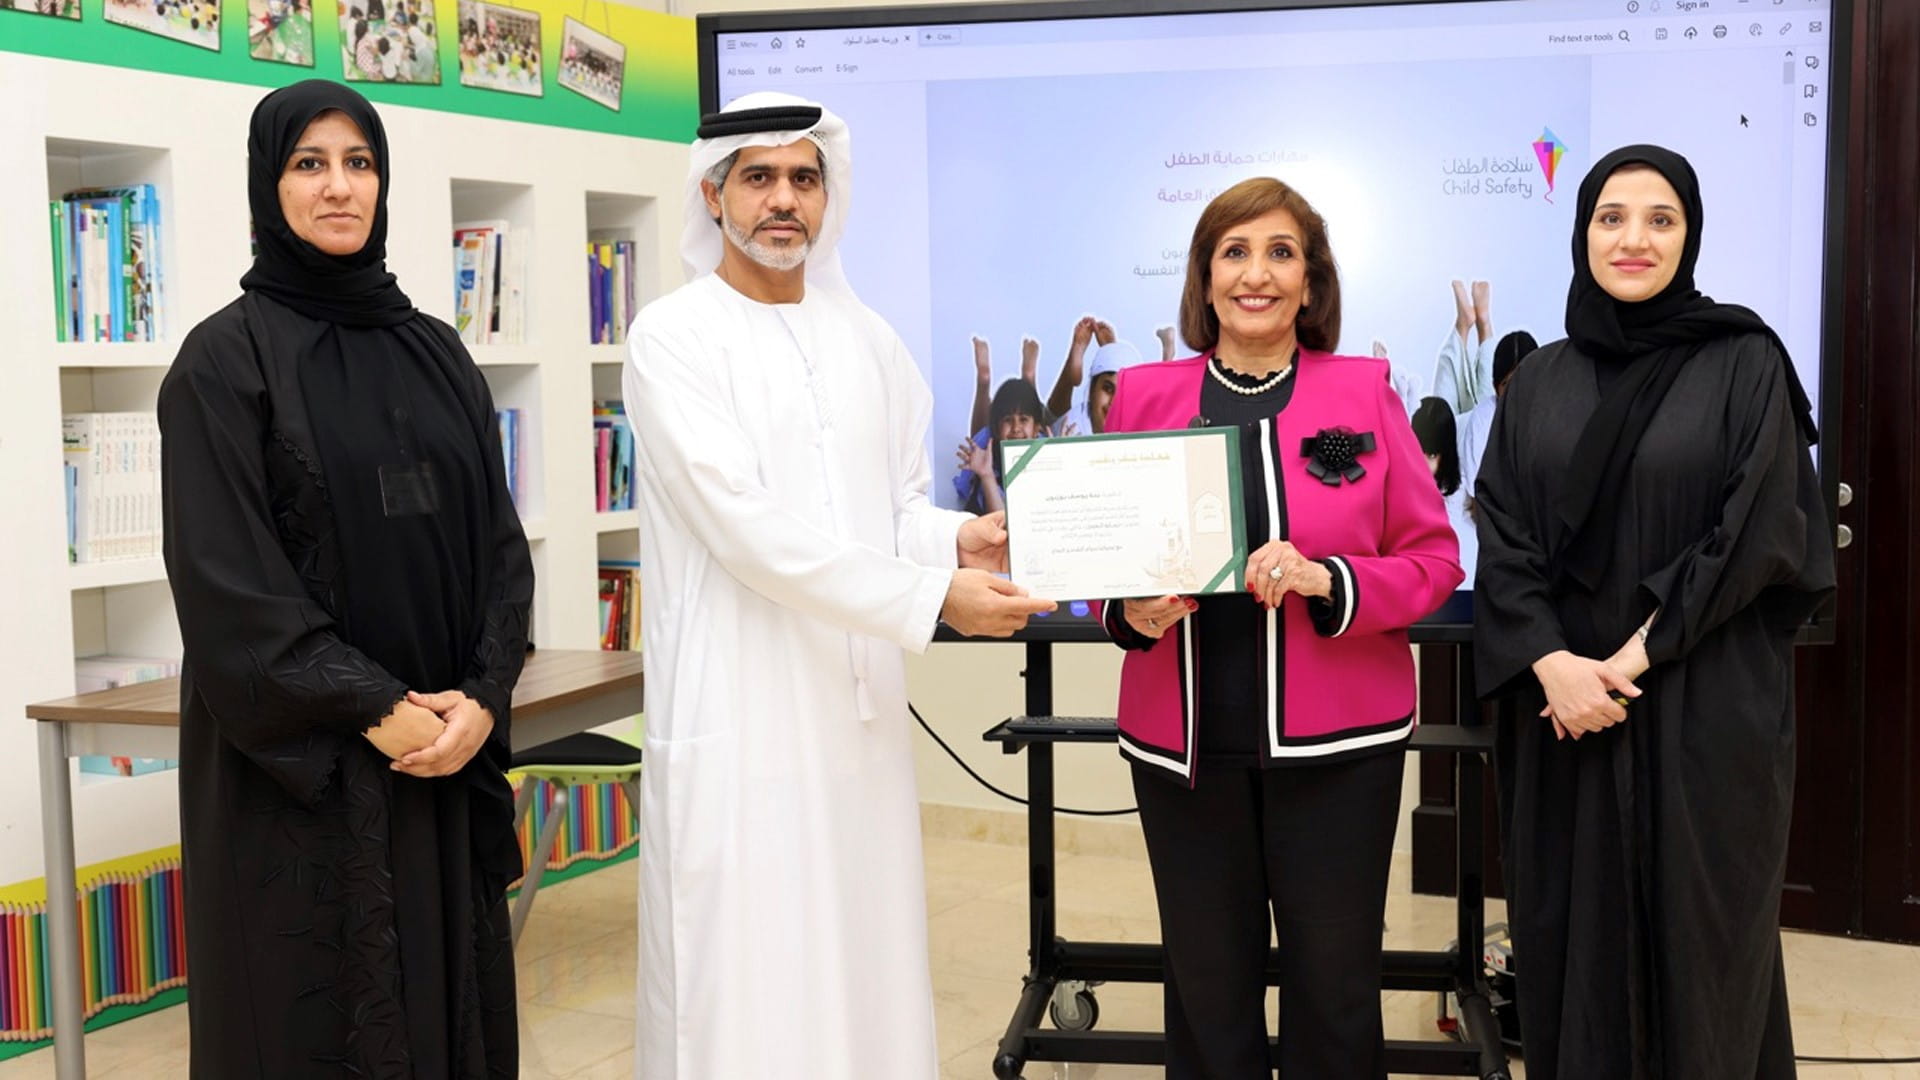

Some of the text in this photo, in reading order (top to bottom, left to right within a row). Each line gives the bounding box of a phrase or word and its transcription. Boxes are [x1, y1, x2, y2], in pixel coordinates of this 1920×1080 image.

[1676, 0, 1698, 12] Sign
[1549, 32, 1613, 43] Find text or tools
[727, 67, 755, 76] All tools
[768, 66, 782, 75] Edit
[795, 65, 823, 74] Convert
[836, 63, 859, 73] E-Sign
[1165, 152, 1210, 168] الطفل
[1213, 150, 1255, 167] حماية
[1443, 157, 1488, 174] الطفل
[1443, 177, 1533, 199] Child Safety
[1158, 188, 1202, 202] العامة
[1133, 265, 1180, 280] النفسية
